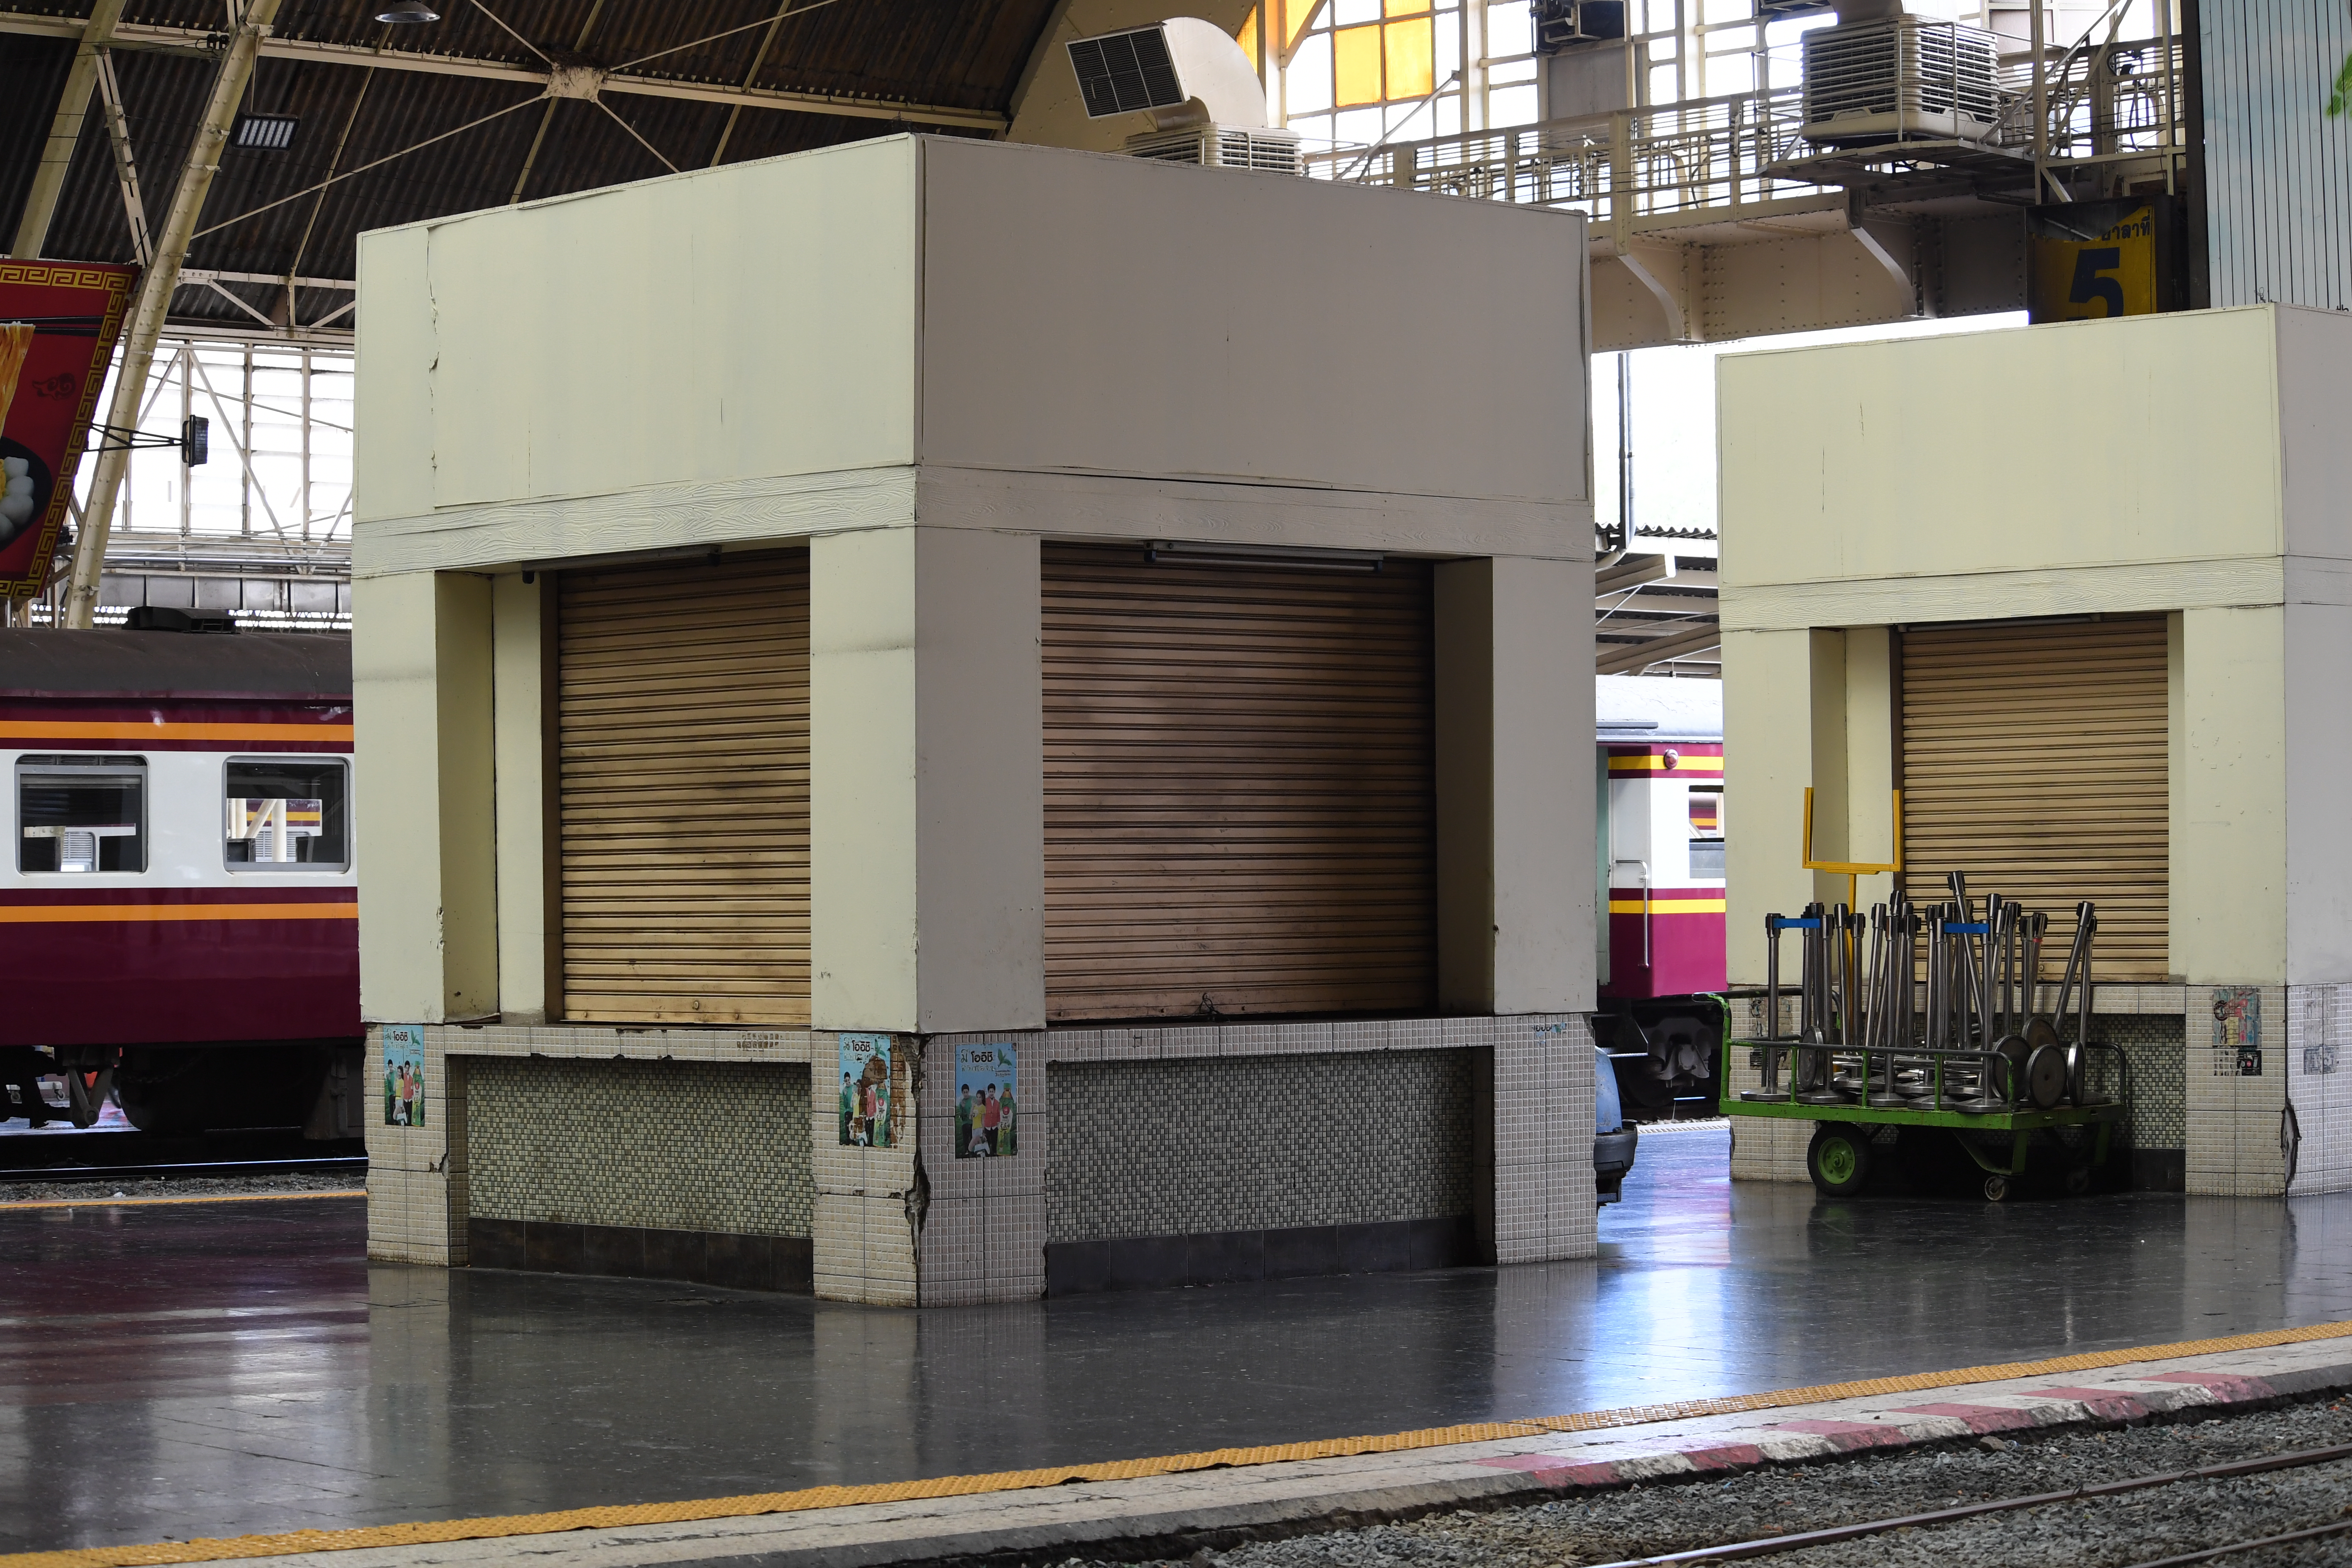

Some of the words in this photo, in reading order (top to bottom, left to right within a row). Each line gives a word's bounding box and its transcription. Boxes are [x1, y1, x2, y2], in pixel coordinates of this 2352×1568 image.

[2066, 247, 2124, 320] 5
[393, 1031, 408, 1041] โออิชิ
[852, 1040, 871, 1052] โออิชิ
[961, 1049, 968, 1063] มี
[971, 1051, 993, 1063] โออิชิ
